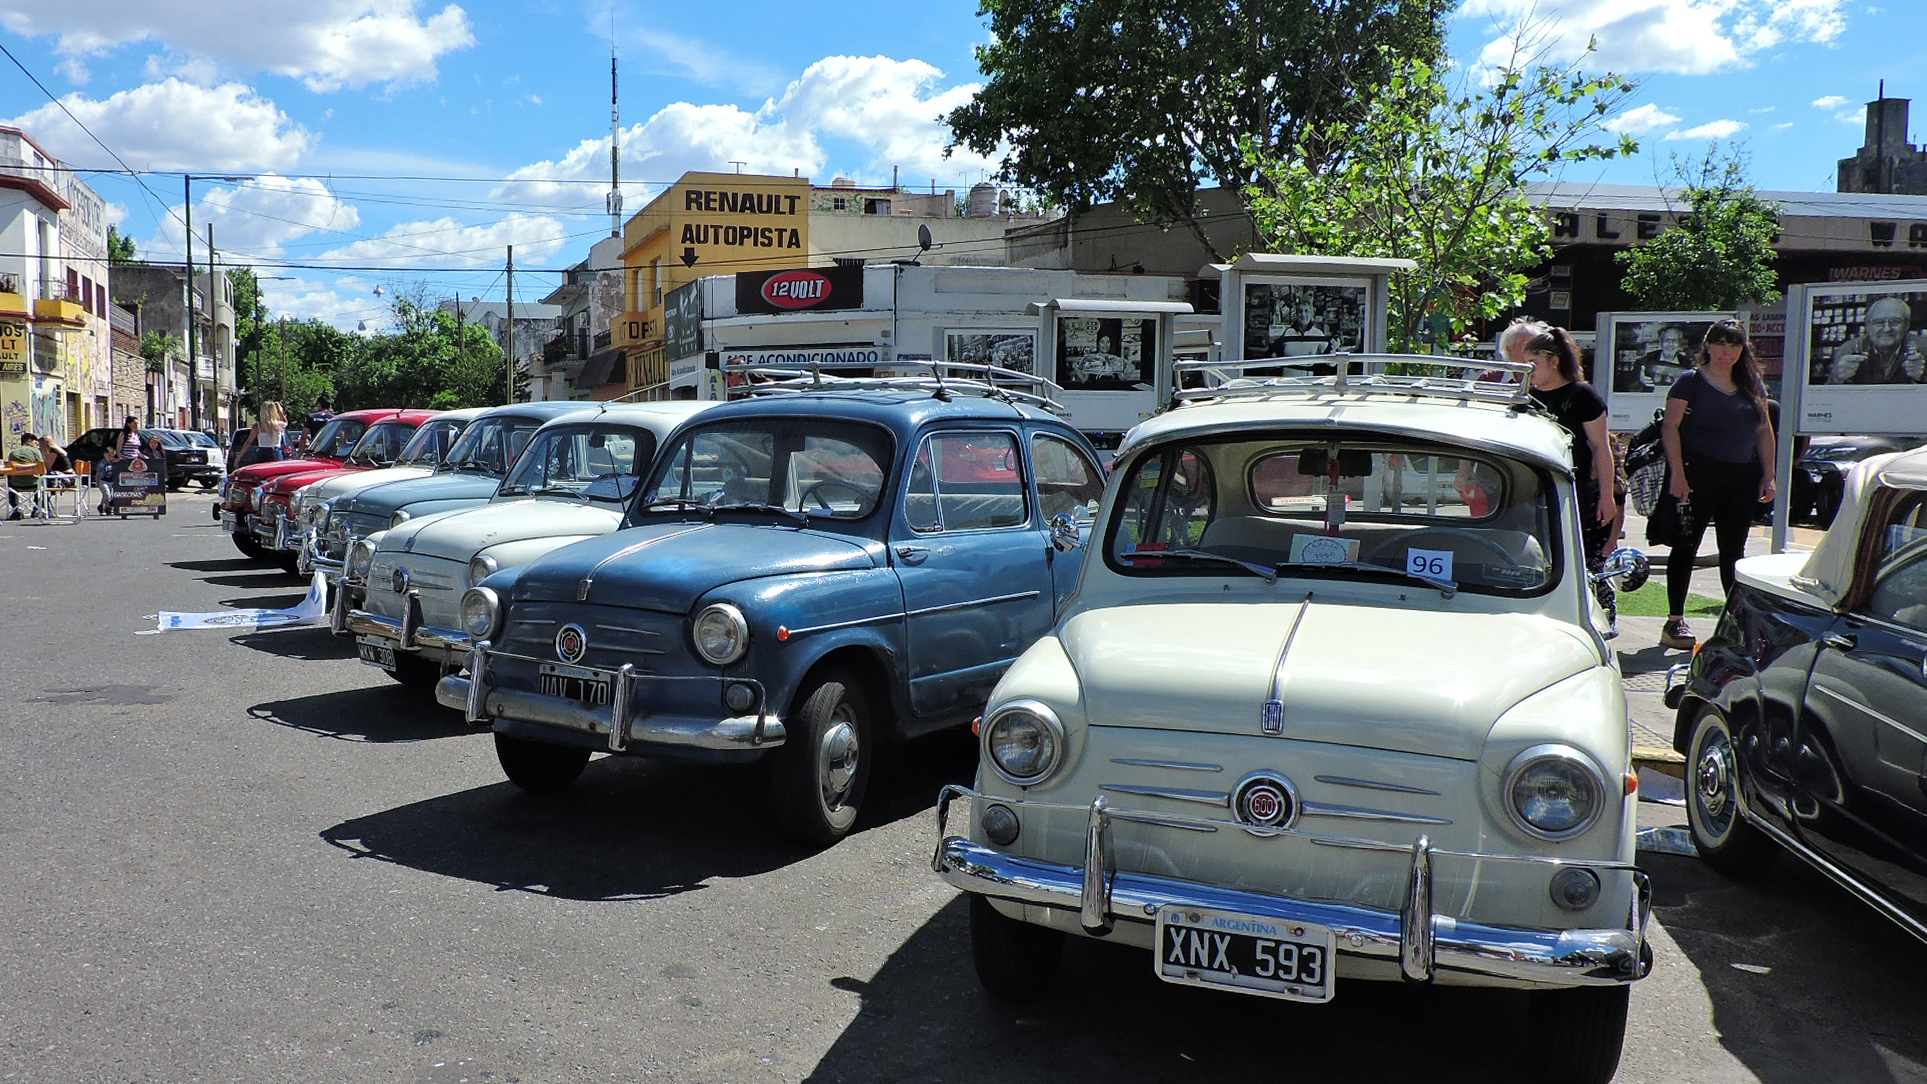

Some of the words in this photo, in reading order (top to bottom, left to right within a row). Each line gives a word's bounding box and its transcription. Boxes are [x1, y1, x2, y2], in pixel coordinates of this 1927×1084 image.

[685, 190, 801, 215] RENAULT
[681, 224, 801, 249] AUTOPISTA
[726, 354, 753, 365] RE
[758, 350, 878, 364] ACONDICIONADO
[1412, 556, 1443, 575] 96
[577, 680, 608, 706] 170
[1254, 798, 1274, 814] 600
[1212, 917, 1278, 936] ARGENTINA
[1168, 927, 1232, 971] XNX
[1255, 939, 1322, 985] 593
